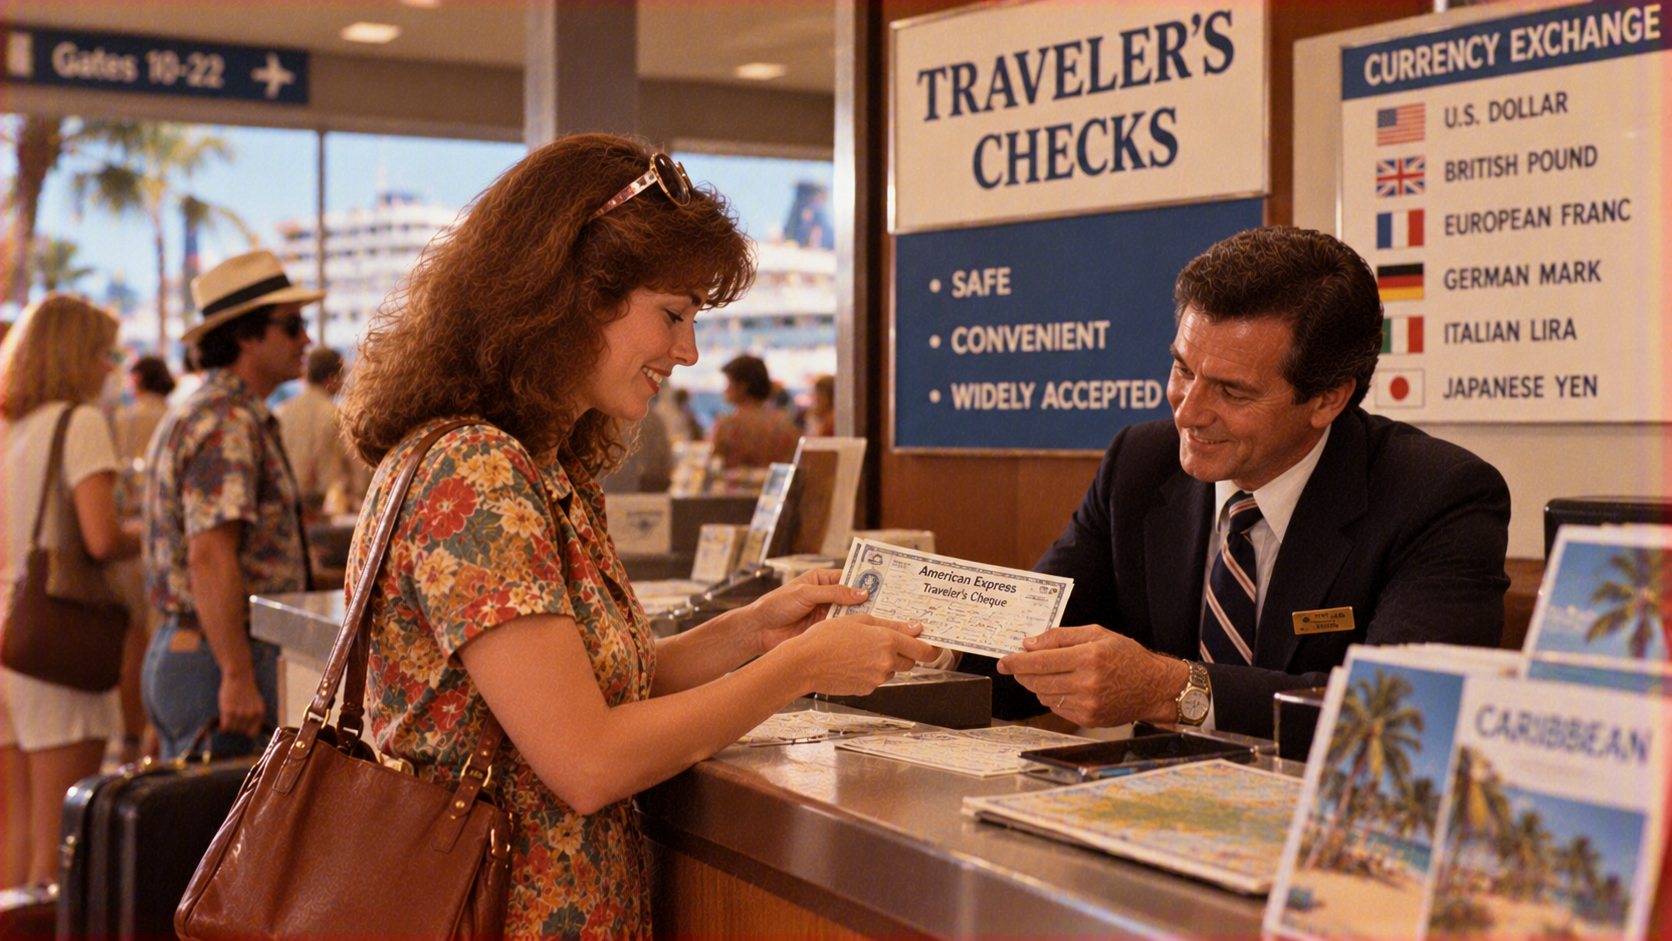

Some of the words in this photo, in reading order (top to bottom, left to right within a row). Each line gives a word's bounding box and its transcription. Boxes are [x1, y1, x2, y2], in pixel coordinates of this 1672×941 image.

[1364, 32, 1500, 86] CURRENCY
[1510, 4, 1661, 61] EXCHANGE
[52, 41, 138, 82] Gates
[145, 49, 226, 89] 10-22
[917, 10, 1235, 122] TRAVELER'S
[1444, 103, 1480, 128] U.S.
[1489, 91, 1568, 123] DOLLAR
[972, 107, 1178, 189] CHECKS
[1445, 154, 1518, 182] BRITISH
[1528, 145, 1598, 173] POUND
[1445, 206, 1551, 236] EUROPEAN
[1561, 198, 1631, 226] FRANC
[951, 267, 1011, 298] SAFE
[1444, 264, 1529, 290] GERMAN
[1539, 260, 1602, 285] MARK
[951, 320, 1110, 355] CONVENIENT
[1444, 321, 1520, 344] ITALIAN
[1530, 318, 1577, 341] LIRA
[951, 381, 1036, 410] WIDELY
[1041, 379, 1162, 409] ACCEPTED
[1443, 375, 1545, 399] JAPANESE
[1555, 374, 1598, 397] YEN
[918, 565, 972, 585] American
[973, 576, 1018, 594] Express
[923, 583, 967, 600] Traveler's
[970, 591, 1008, 608] Cheque
[1475, 705, 1652, 762] CARIBBEAN
